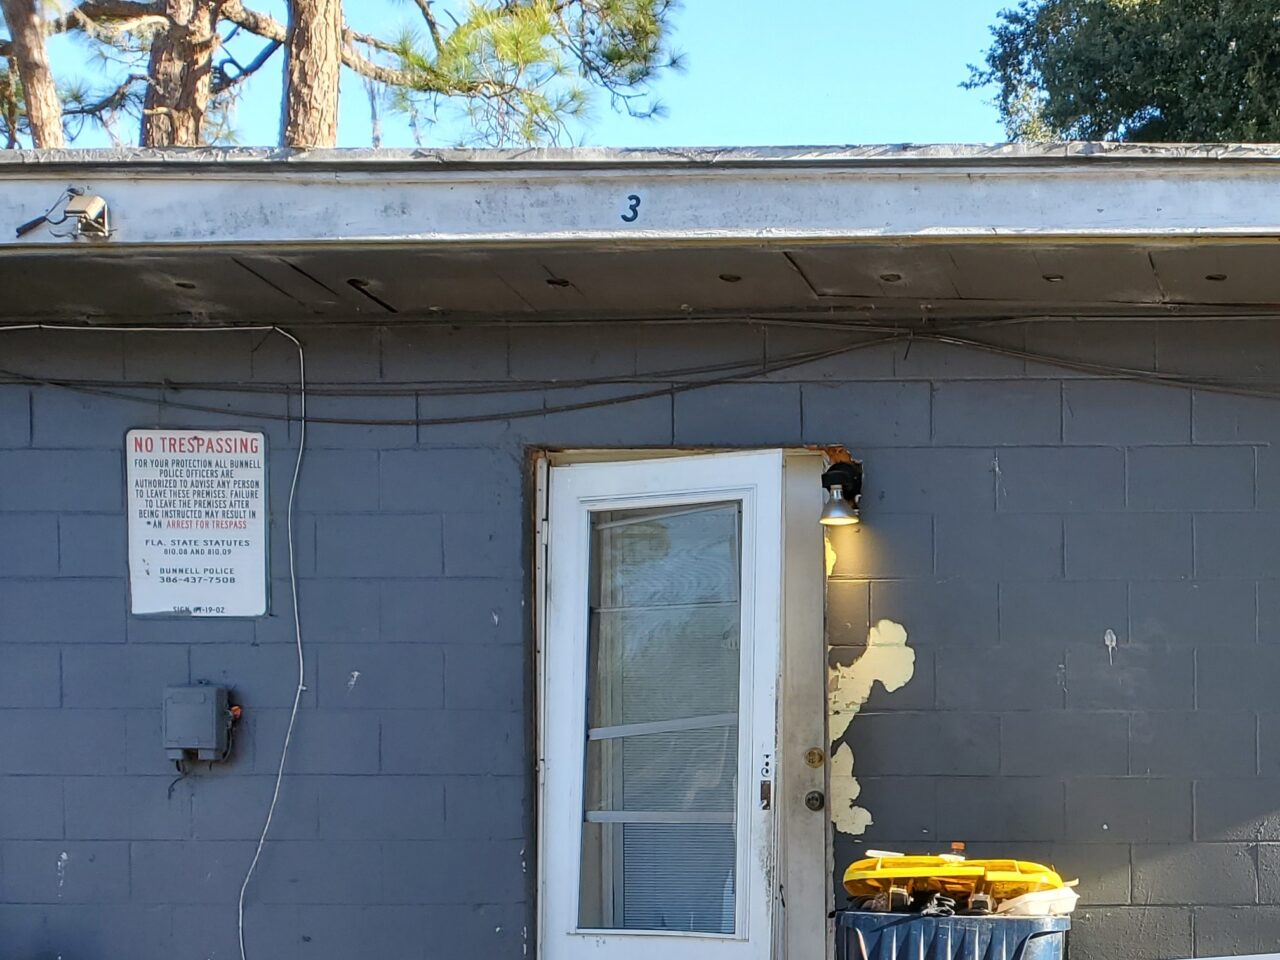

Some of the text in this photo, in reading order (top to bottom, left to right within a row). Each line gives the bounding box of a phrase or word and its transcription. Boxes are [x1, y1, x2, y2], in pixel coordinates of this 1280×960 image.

[620, 194, 641, 223] 3
[134, 436, 259, 454] NO TRESPASSING
[134, 458, 261, 468] FOR YOUR PROTECTION ALL BUNNELL
[160, 469, 234, 478] POLICE OFFICERS ARE
[134, 480, 260, 489] AUTHORIZED TO ADVISE ANY PERSON
[136, 490, 144, 499] TO
[146, 490, 167, 499] LEAVE
[170, 490, 192, 499] THESE
[230, 490, 259, 499] FAILURE
[145, 500, 250, 508] TO LEAVE THE PREMISES AFTER
[138, 510, 256, 519] BEING INSTRUCTED MAY RESULT IN
[152, 520, 247, 529] AN ARREST FOR TRESPASS
